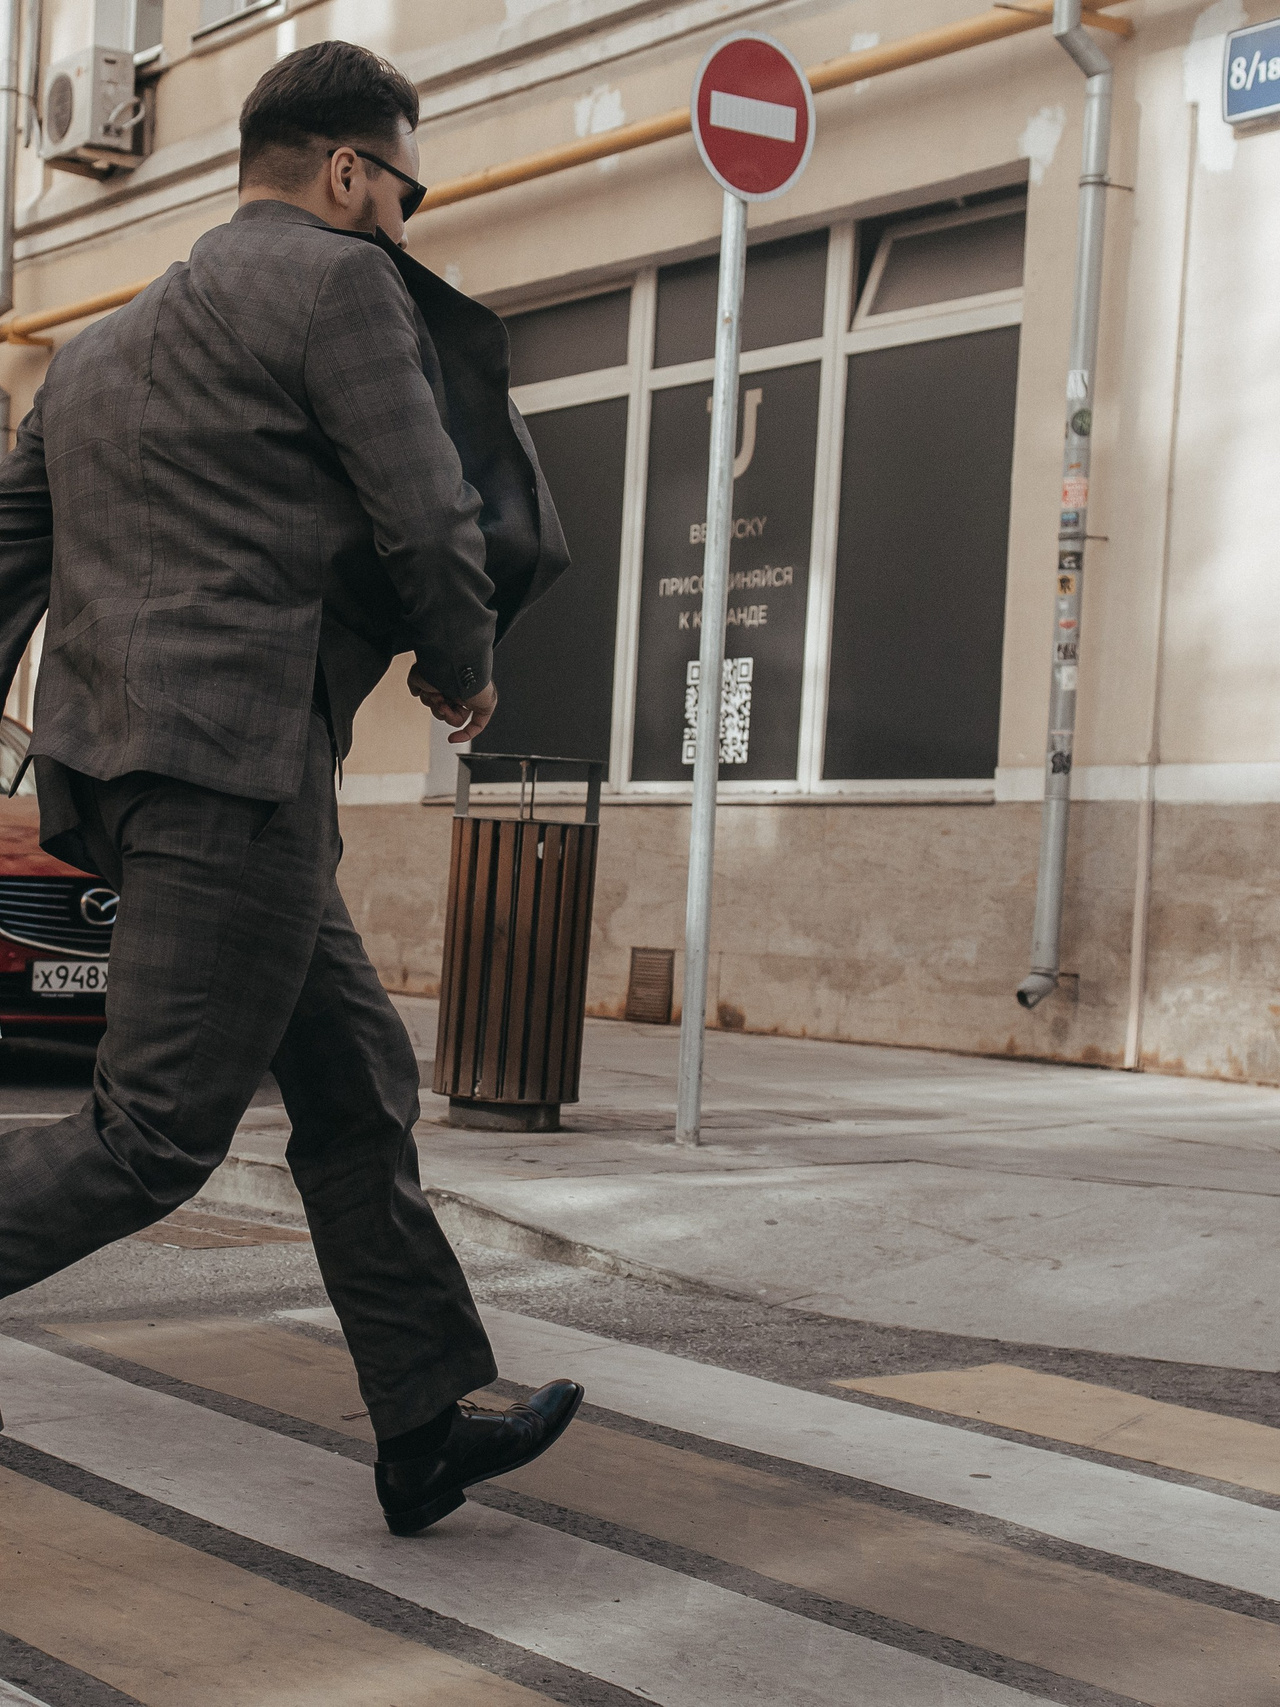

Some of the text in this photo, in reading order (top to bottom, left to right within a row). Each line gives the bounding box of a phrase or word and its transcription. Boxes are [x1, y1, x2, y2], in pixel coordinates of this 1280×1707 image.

[1229, 50, 1280, 91] 8/18
[659, 565, 793, 597] ПРИСИНЯЙСЯ
[678, 604, 769, 631] К КАНДЕ
